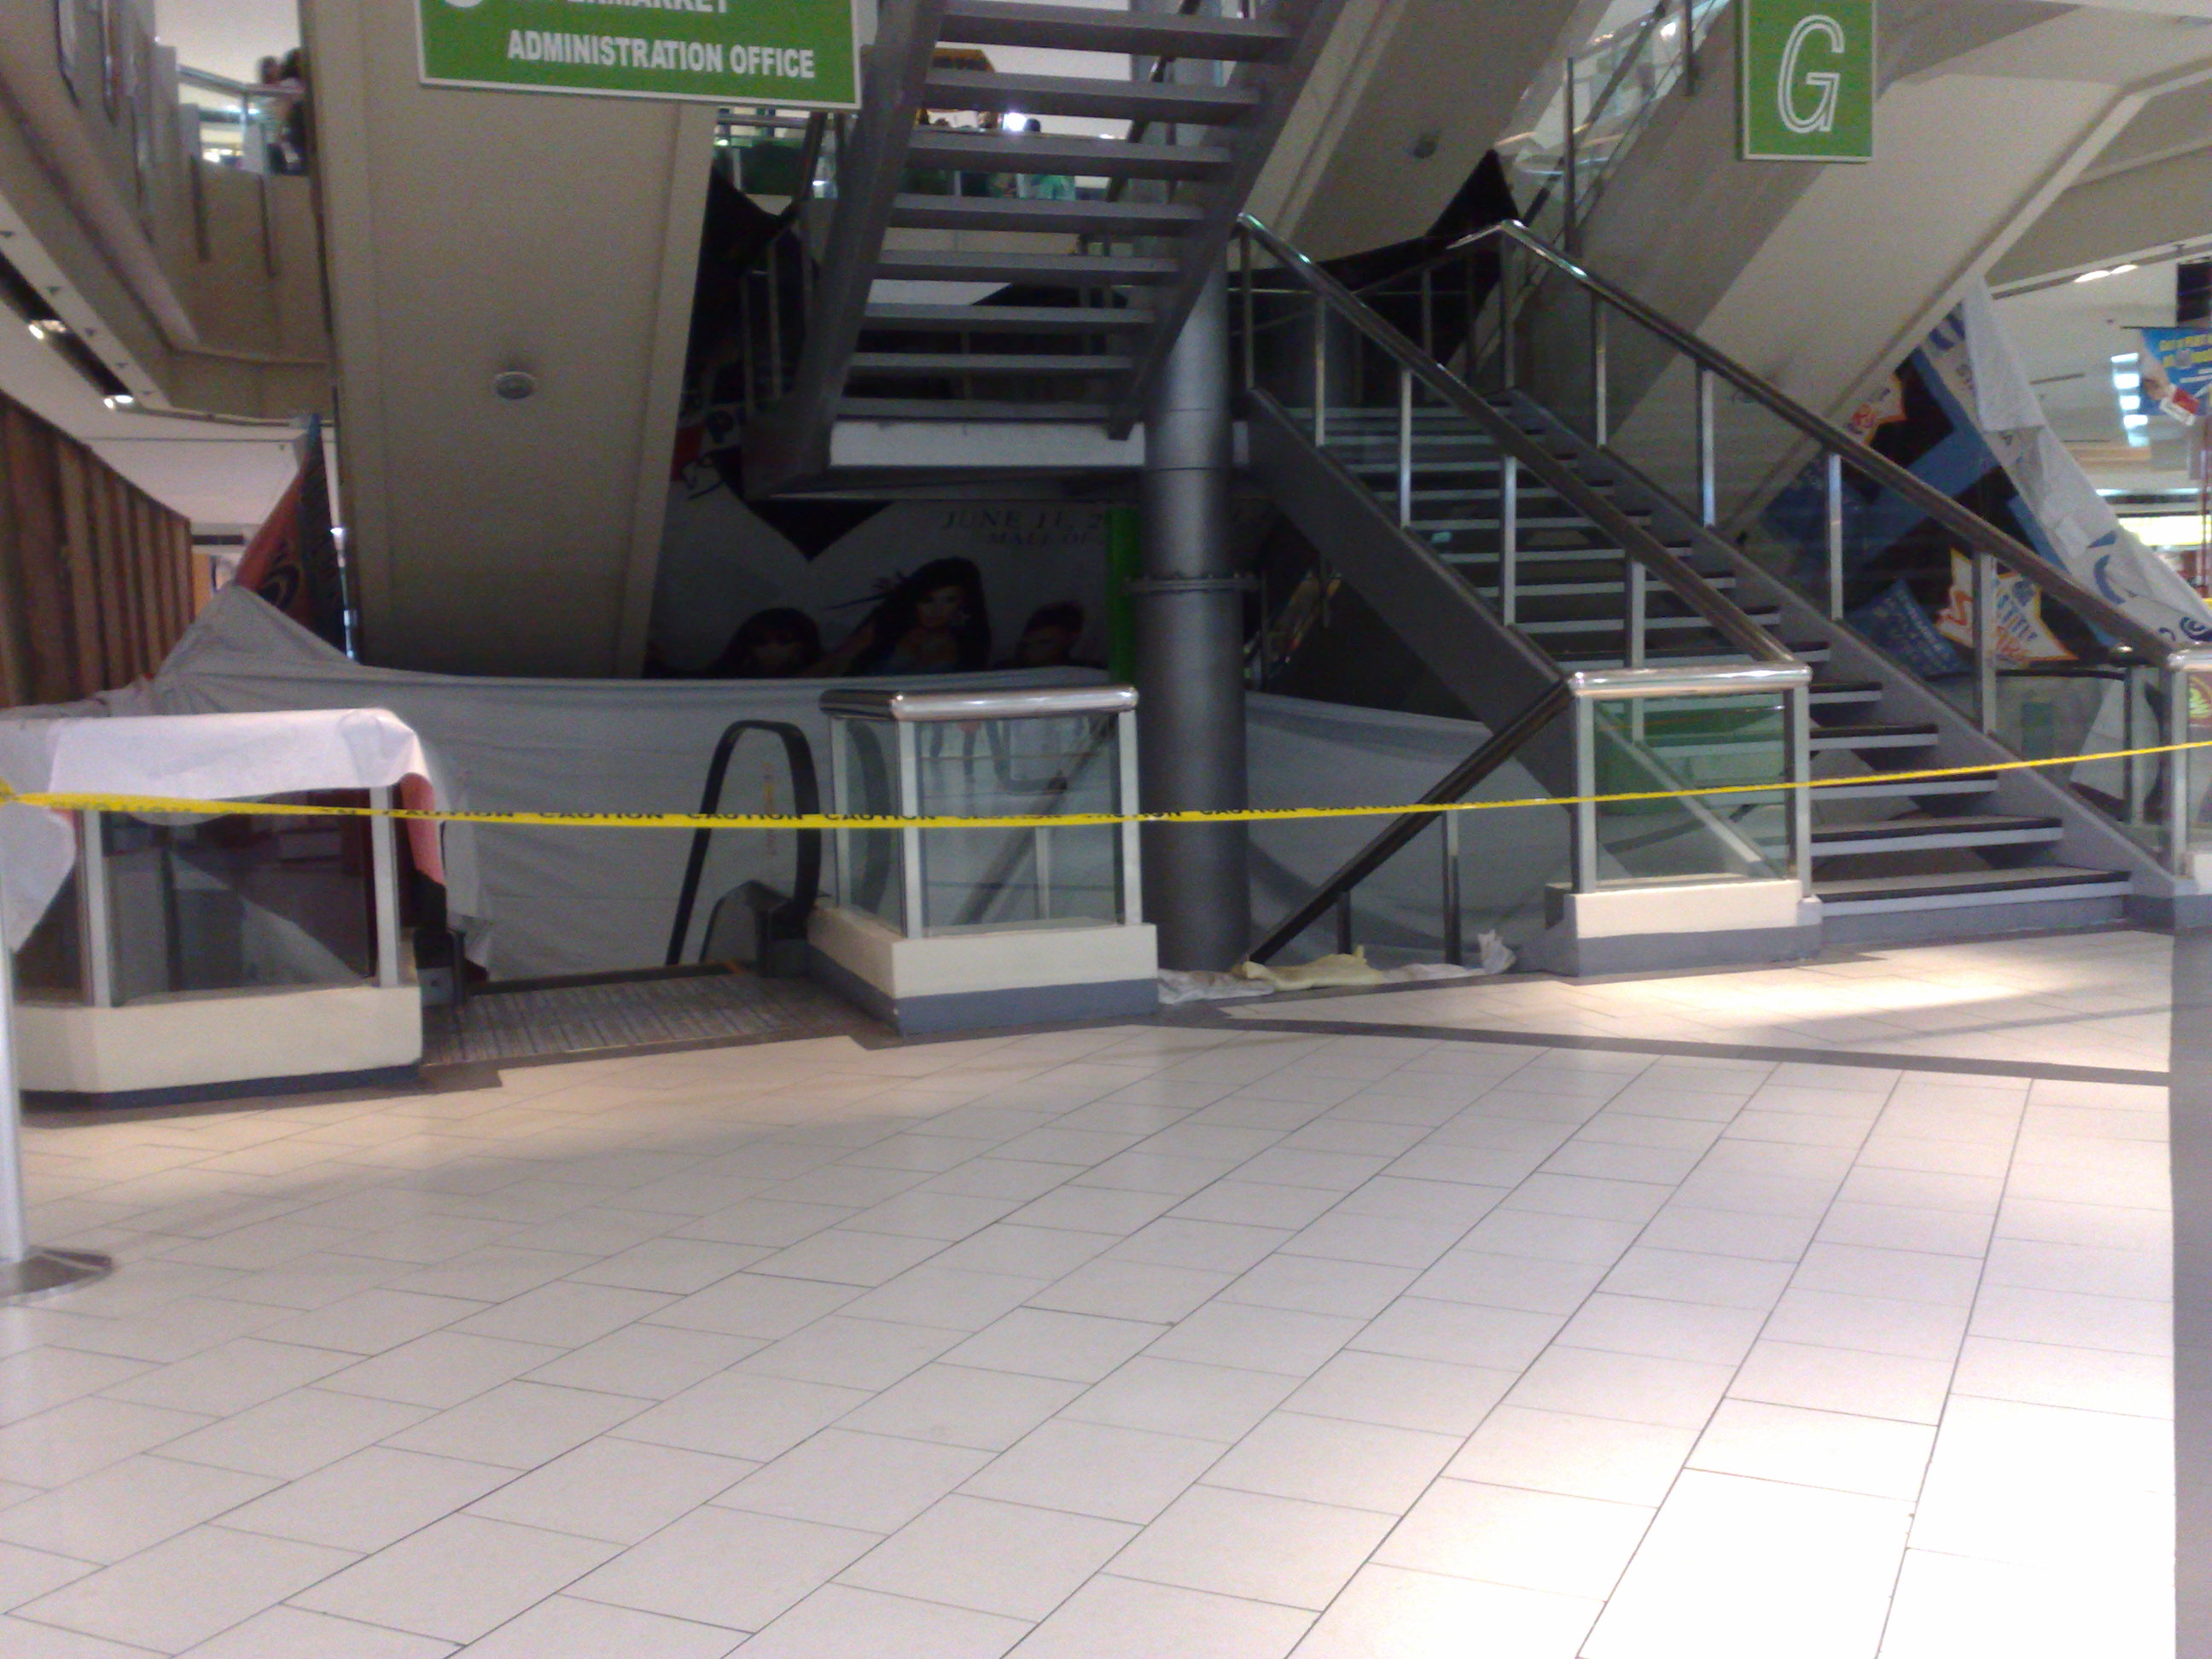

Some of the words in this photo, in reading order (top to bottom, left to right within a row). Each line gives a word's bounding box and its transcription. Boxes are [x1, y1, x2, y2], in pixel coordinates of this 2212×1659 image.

[508, 29, 724, 73] ADMINISTRATION
[730, 44, 815, 79] OFFICE
[1778, 14, 1846, 134] G
